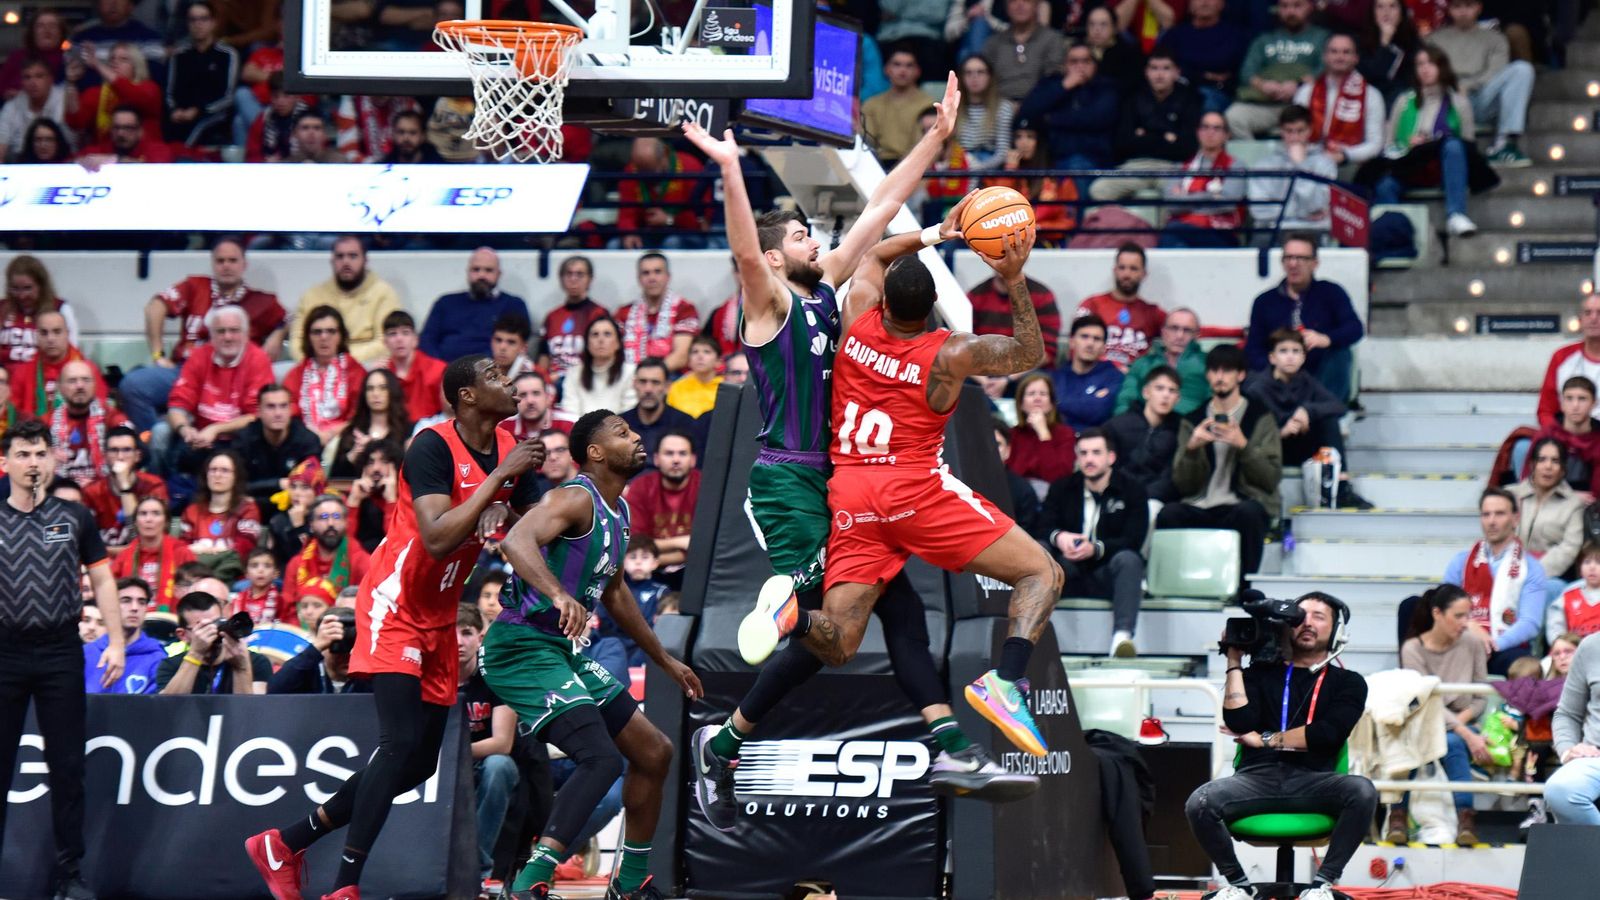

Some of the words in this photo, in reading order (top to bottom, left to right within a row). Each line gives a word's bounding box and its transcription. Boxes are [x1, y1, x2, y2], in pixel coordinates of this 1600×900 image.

[38, 186, 112, 205] ESP
[438, 187, 513, 206] ESP
[980, 208, 1029, 230] Wilson
[844, 335, 901, 379] CAUPAIN
[898, 362, 922, 385] JR.
[838, 400, 894, 455] 10
[889, 509, 917, 522] MURCIA
[439, 560, 461, 592] 21
[1035, 689, 1069, 715] LABASA
[6, 714, 443, 806] endes
[734, 739, 931, 798] ESP
[1001, 752, 1022, 774] LET'S
[1022, 752, 1037, 775] GO
[1037, 750, 1072, 775] BEYOND
[744, 801, 890, 819] OLUTIONS
